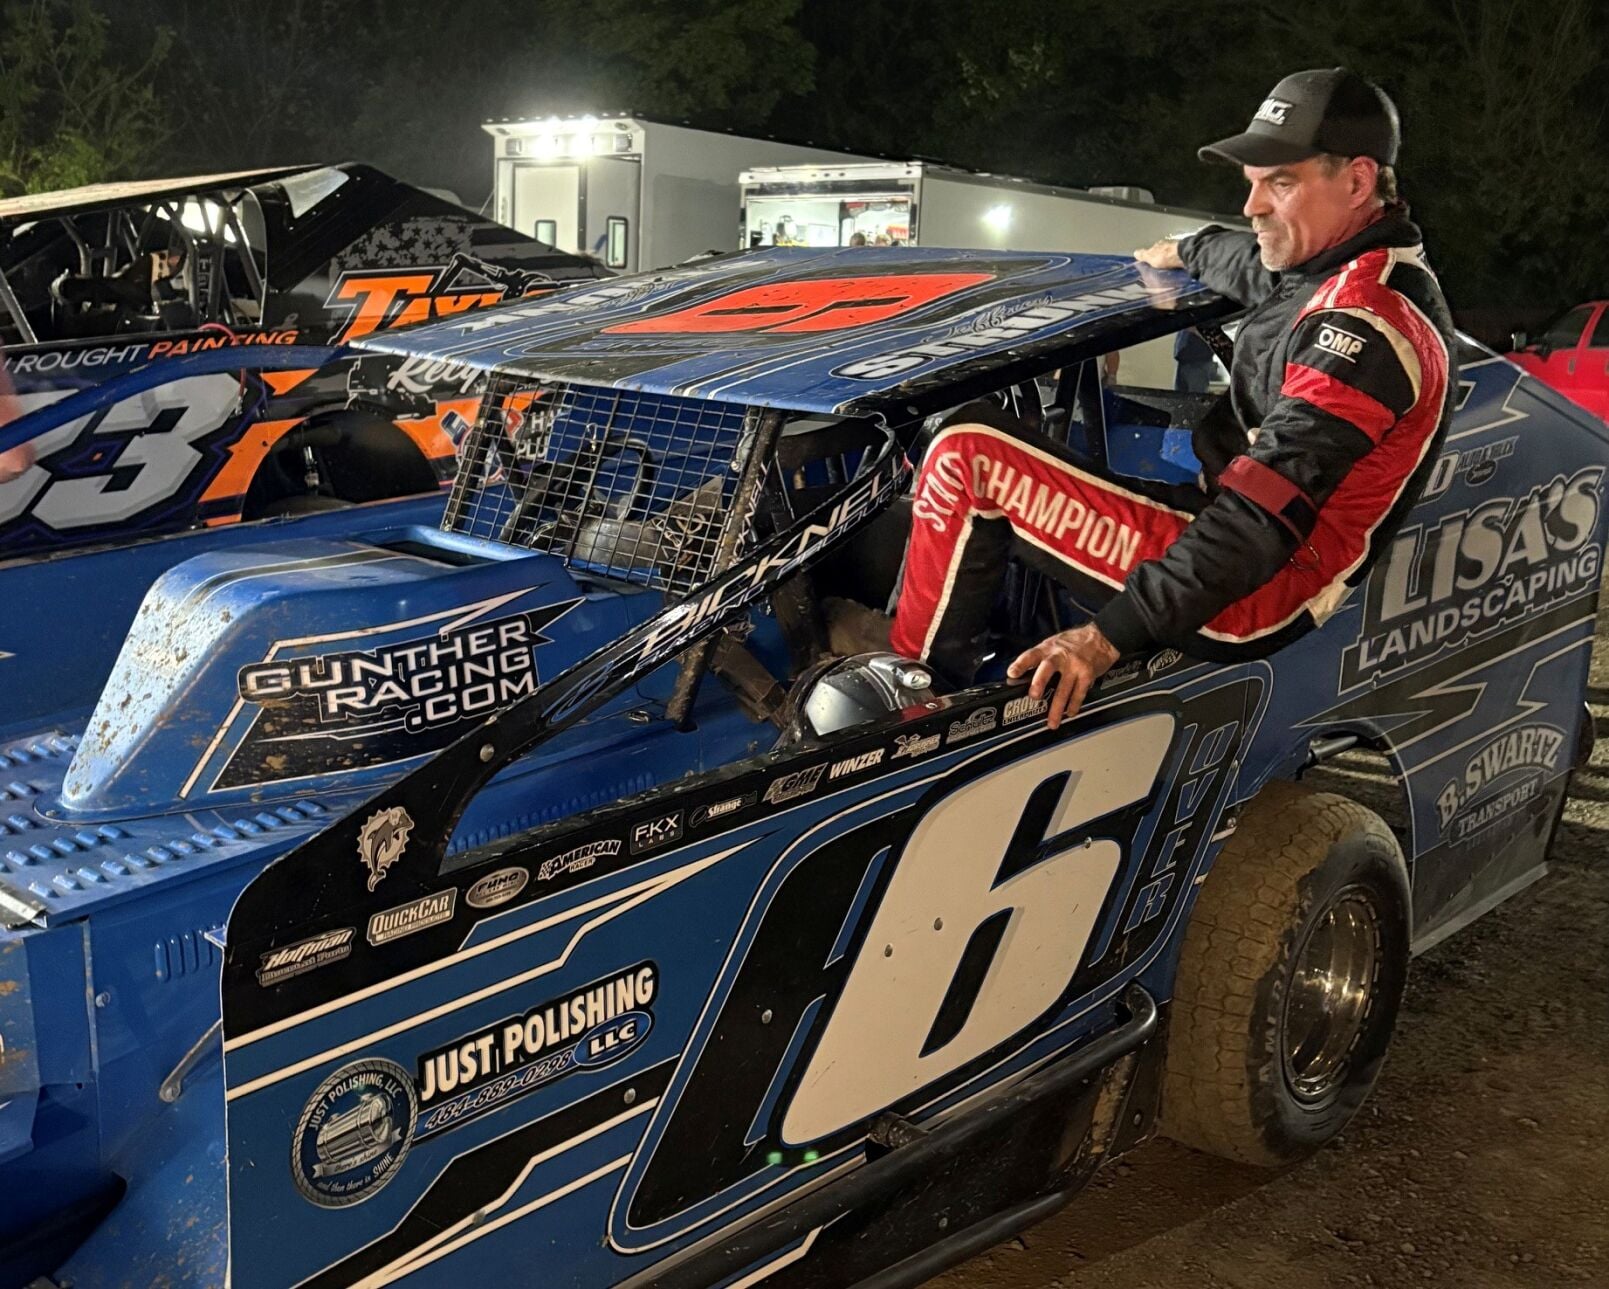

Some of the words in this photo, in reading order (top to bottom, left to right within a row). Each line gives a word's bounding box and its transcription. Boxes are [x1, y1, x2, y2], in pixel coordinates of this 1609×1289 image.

[1318, 330, 1363, 356] OMP
[971, 453, 1142, 572] CHAMPION
[1380, 474, 1604, 622] LISA'S
[1358, 550, 1598, 672] LANDSCAPING
[246, 619, 530, 697] GUNTHER
[327, 646, 531, 714] RACING
[828, 748, 886, 780] WINZER
[1457, 780, 1538, 838] TRANSPORT
[549, 840, 622, 878] AMERICAN
[781, 712, 1176, 1145] 6
[421, 1033, 494, 1101] JUST
[503, 966, 654, 1066] POLISHING
[590, 1021, 637, 1057] LLC
[308, 1102, 329, 1131] JUST
[384, 1078, 403, 1099] LLC
[372, 1153, 394, 1178] SHINE
